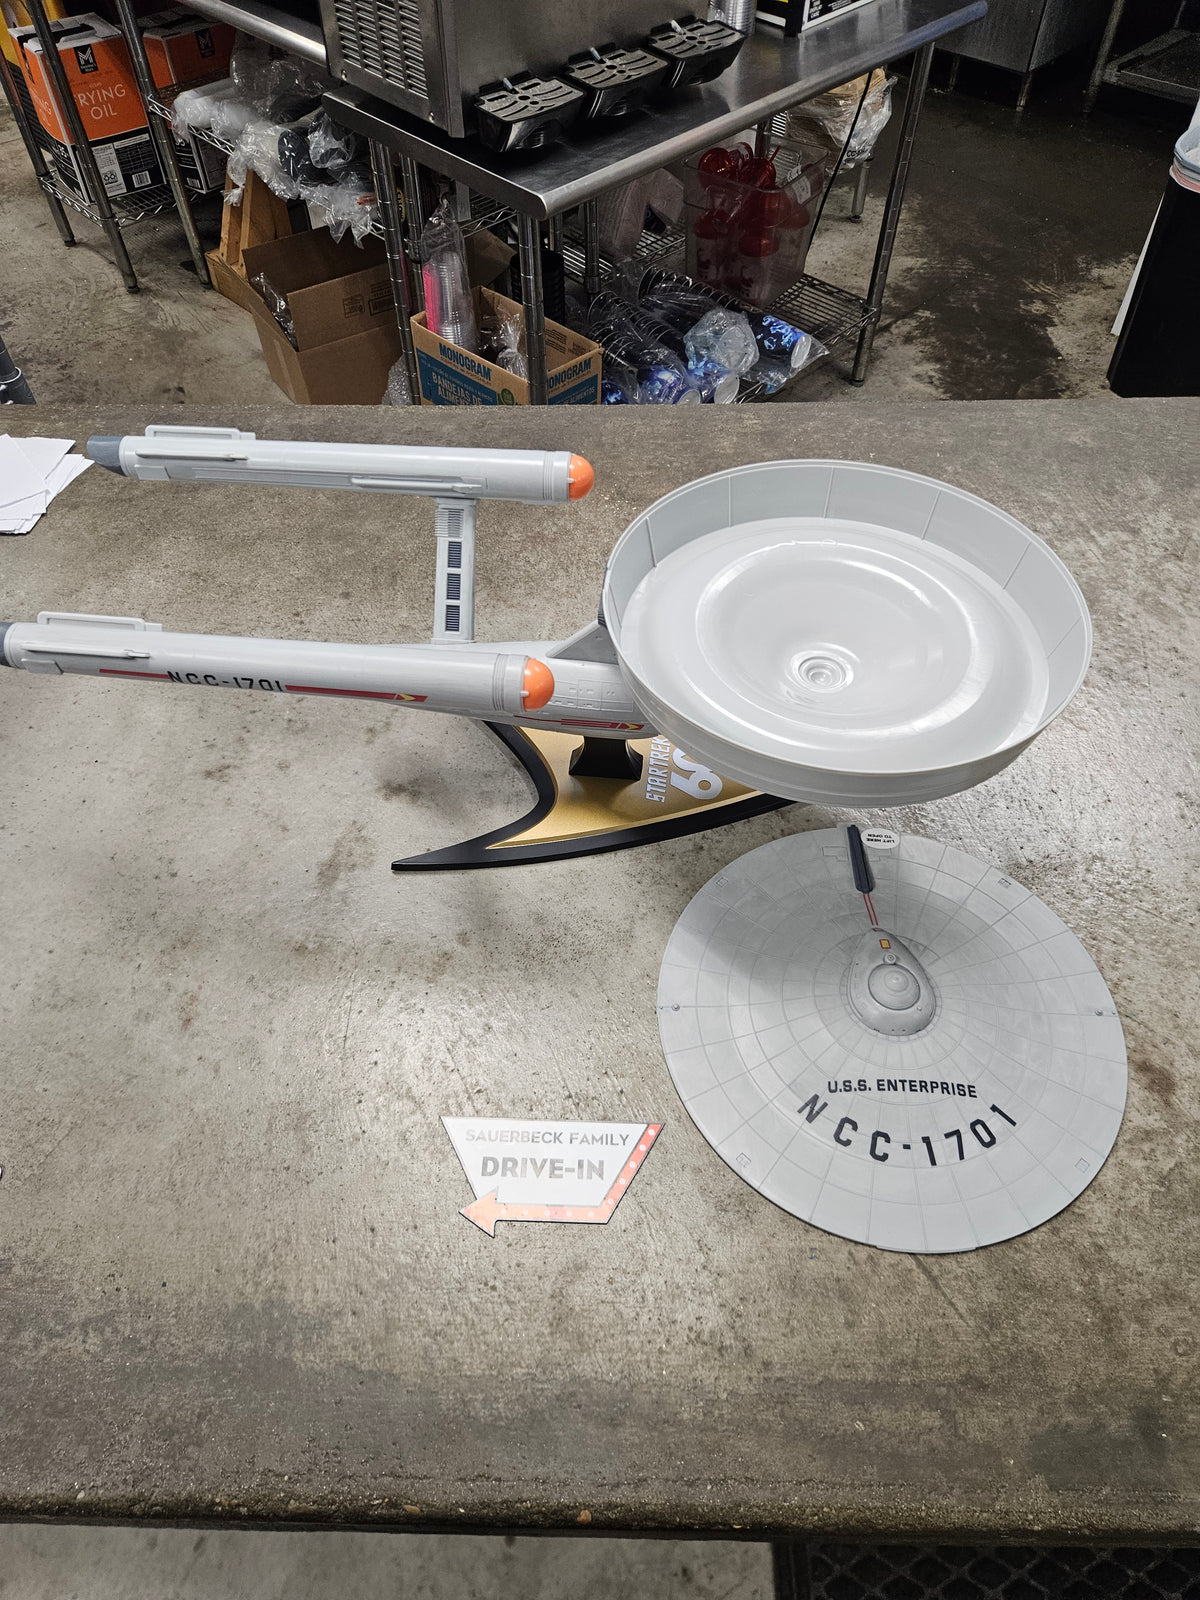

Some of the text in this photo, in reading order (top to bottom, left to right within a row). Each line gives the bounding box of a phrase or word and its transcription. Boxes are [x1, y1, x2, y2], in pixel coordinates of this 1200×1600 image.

[91, 103, 118, 120] OIL
[439, 343, 491, 381] MONOGRAM
[547, 357, 592, 389] ONOGRAM
[167, 671, 283, 692] NCC-1701
[645, 736, 671, 803] STAR TREK
[827, 1079, 978, 1098] U.S.S. ENTERPRISE
[465, 1129, 630, 1146] SAUERBECK FAMILY
[796, 1093, 1017, 1167] NCC-1701
[481, 1155, 605, 1181] DRIVE-IN
